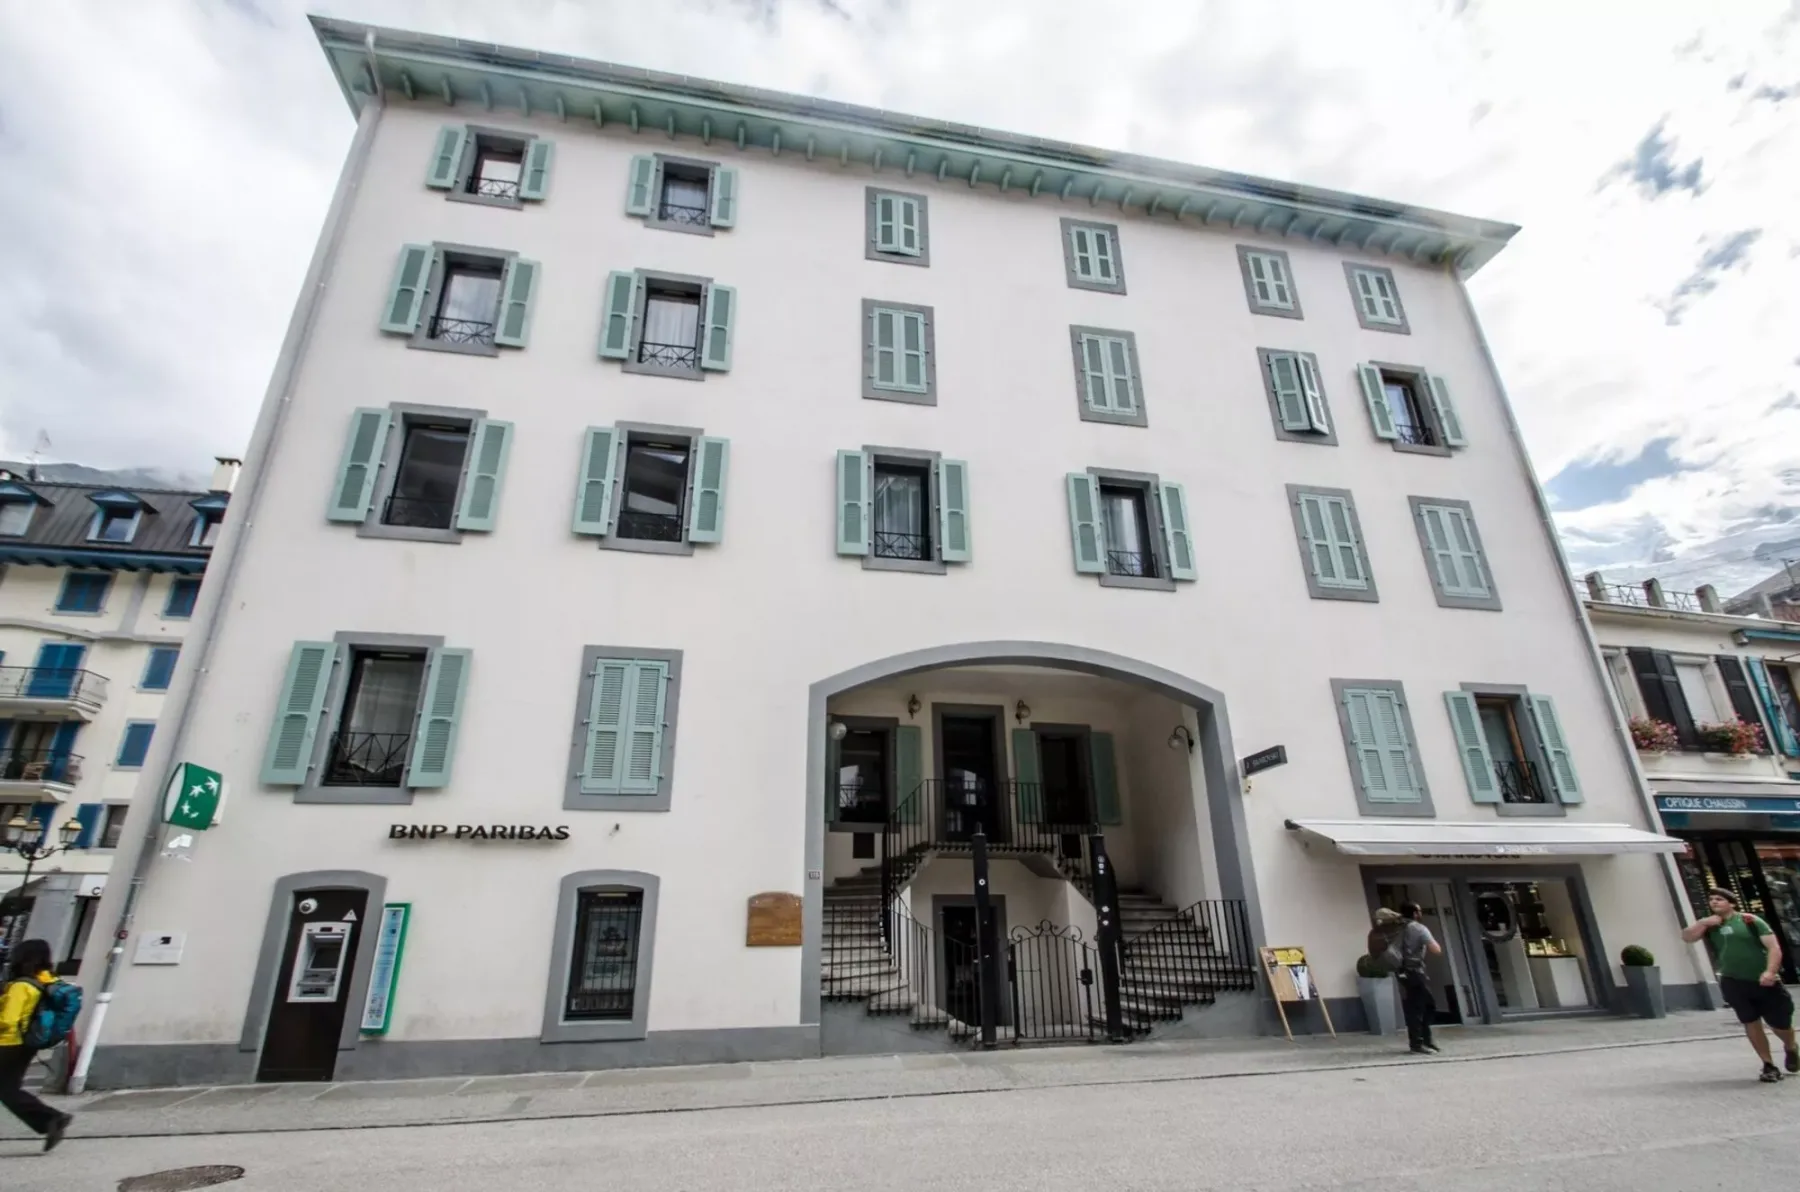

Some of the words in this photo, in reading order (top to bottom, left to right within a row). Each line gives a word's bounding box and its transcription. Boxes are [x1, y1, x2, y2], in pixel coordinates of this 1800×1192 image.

[1664, 797, 1702, 808] OPTIQUE
[1703, 798, 1747, 809] CHAUSSIN
[388, 824, 448, 840] BNP
[455, 824, 570, 841] PARIBAS
